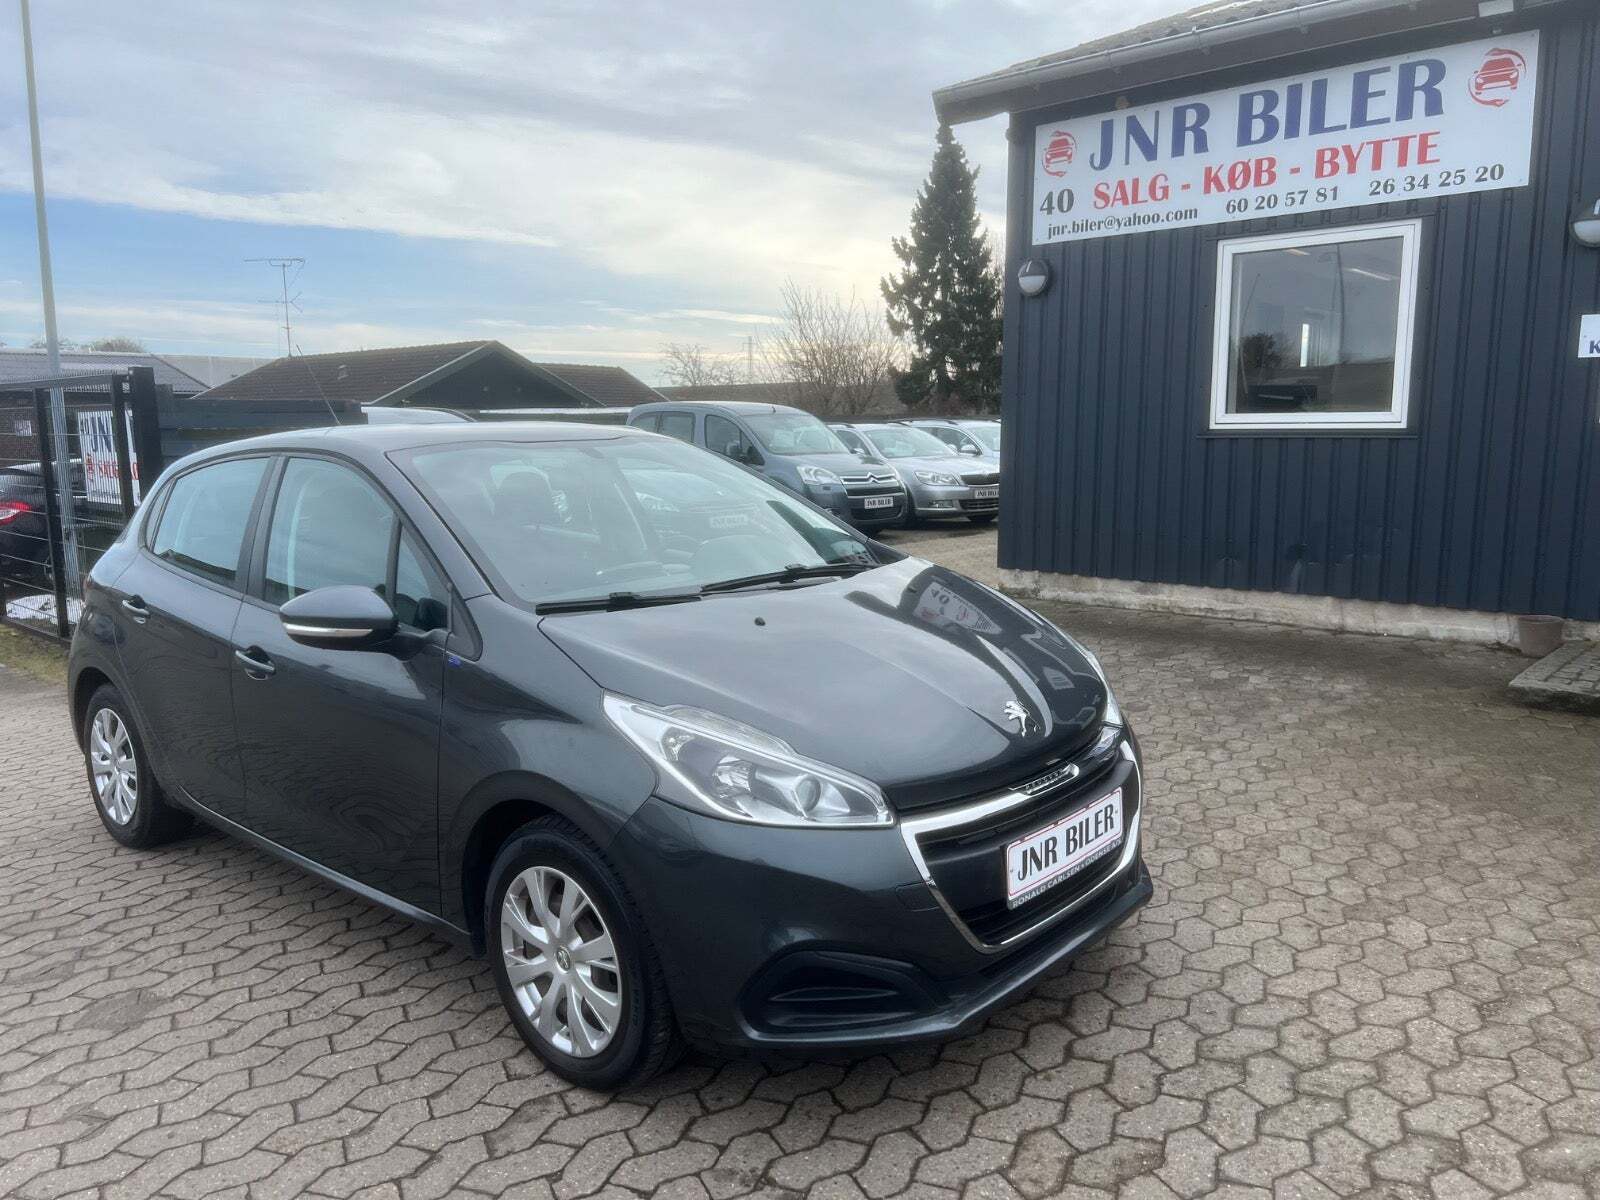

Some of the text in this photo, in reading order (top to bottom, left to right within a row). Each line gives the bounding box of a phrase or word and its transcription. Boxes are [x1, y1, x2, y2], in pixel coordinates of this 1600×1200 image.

[1089, 59, 1446, 171] JNR BILER
[1093, 173, 1169, 210] SALG
[1203, 154, 1277, 194] KØB
[1314, 131, 1441, 179] BYTTE
[1226, 163, 1505, 214] 60 20 57 81 26 34 25 20
[1039, 188, 1075, 216] 40
[1047, 208, 1199, 240] jnr.biler@yahoo.com
[1018, 803, 1114, 881] JNR BILER
[1012, 885, 1046, 908] RONALD
[1047, 865, 1080, 888] CARLSEN
